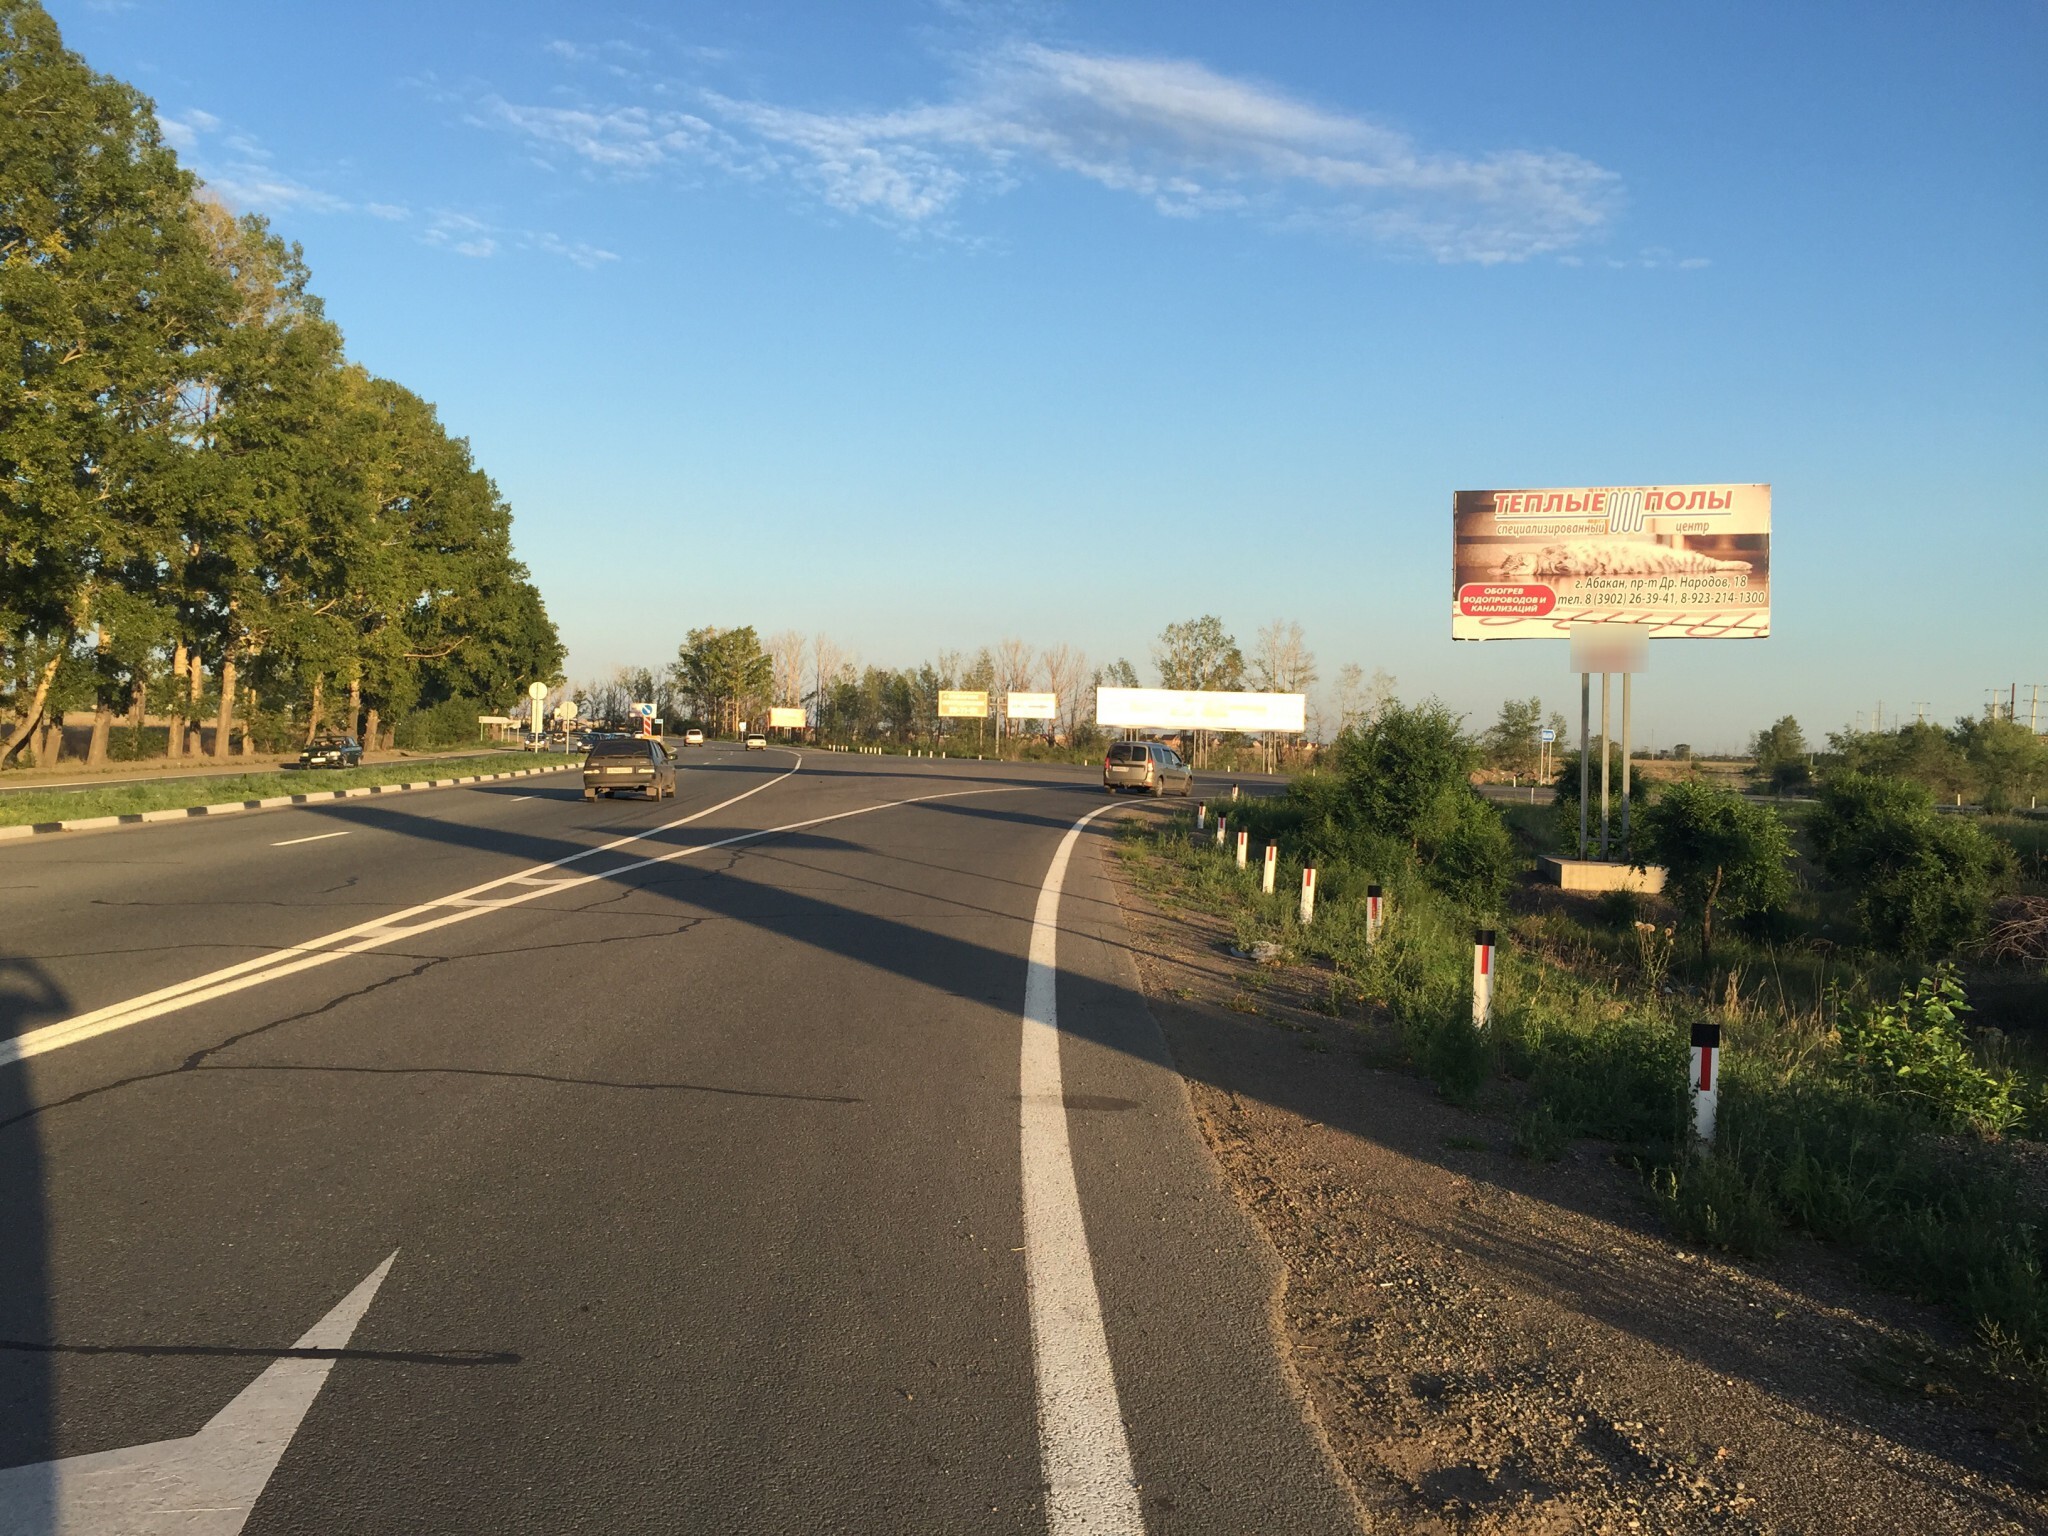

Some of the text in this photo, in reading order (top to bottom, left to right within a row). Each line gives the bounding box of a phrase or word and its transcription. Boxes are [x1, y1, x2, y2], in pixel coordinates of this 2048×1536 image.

[1495, 491, 1733, 513] ТЕПЛЫЕ ПОЛЫ
[1497, 521, 1710, 536] специализированный центр
[1575, 576, 1747, 590] г. Абакан, пр-т Др. Народов, 18
[1484, 587, 1524, 595] ОБОГРЕВ
[1463, 596, 1539, 604] ВОДОПРОВОДОВ
[1557, 591, 1765, 606] тел. 8 (3902) 26-39-41, 8-923-214-1300
[1470, 604, 1538, 613] КАНАЛИЗАЦИЙ
